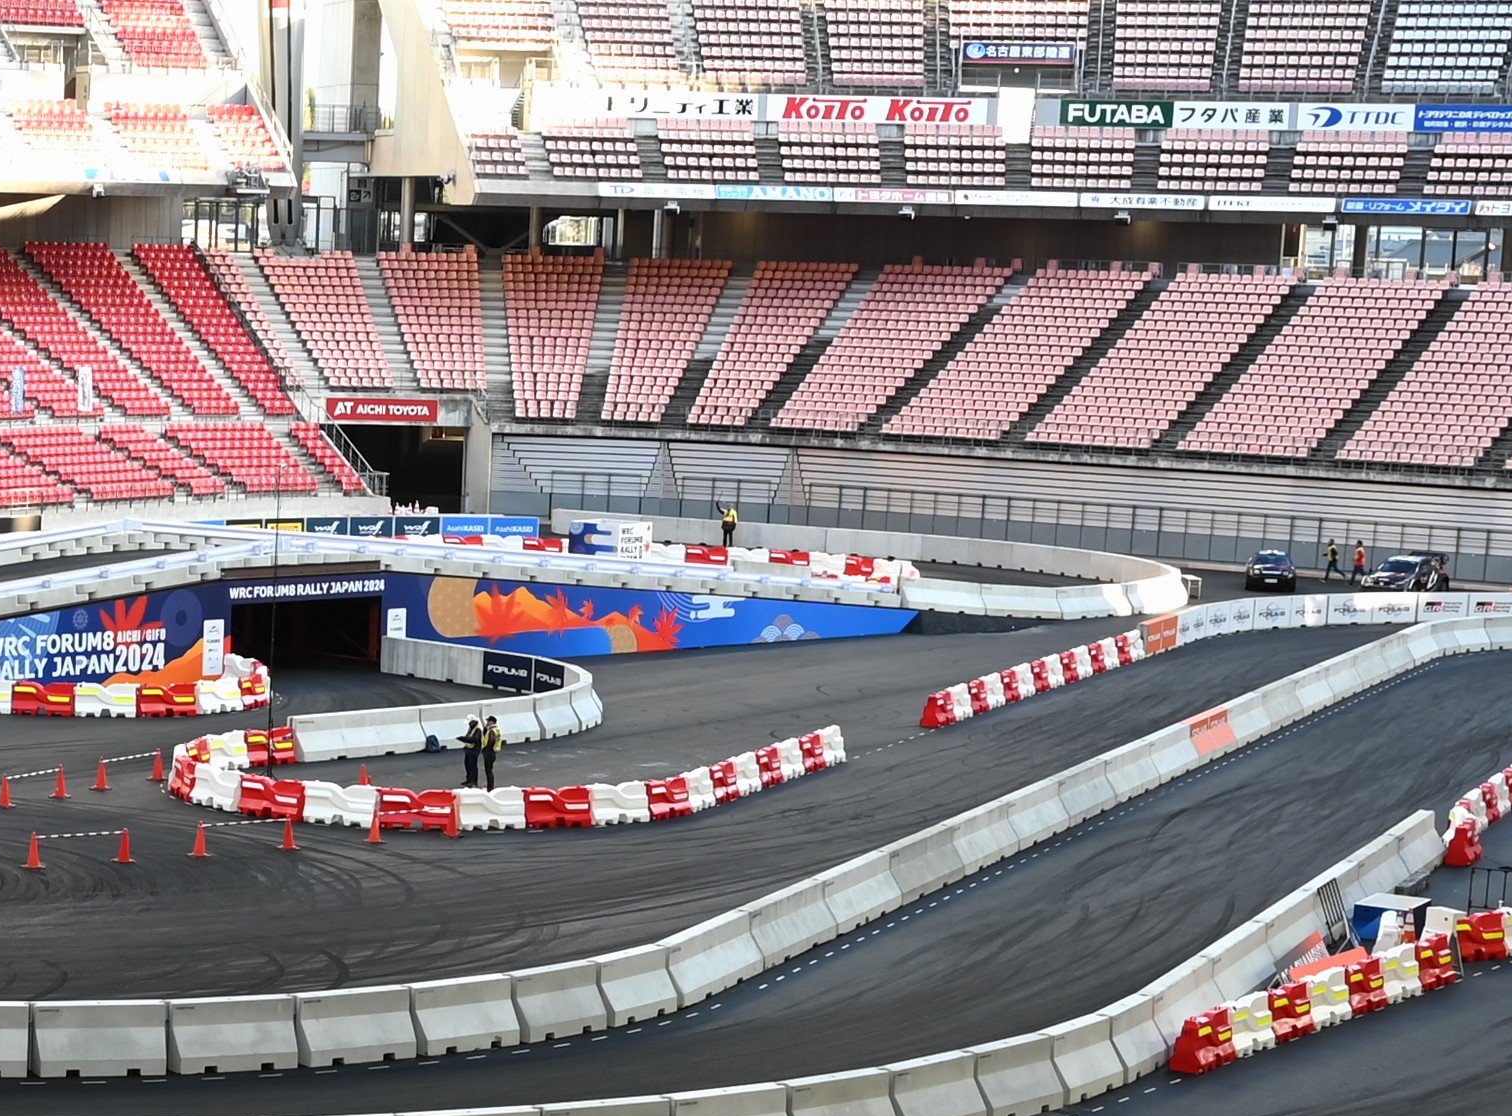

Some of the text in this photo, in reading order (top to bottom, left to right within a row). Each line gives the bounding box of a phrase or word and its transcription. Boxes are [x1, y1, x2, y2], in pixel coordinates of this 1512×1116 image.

[1067, 104, 1165, 124] FUTABA
[1179, 107, 1285, 124] フタバ産業
[1347, 111, 1406, 125] TTDC
[748, 186, 833, 200] AMANO
[356, 404, 386, 415] AICHI
[388, 405, 430, 416] TOYOTA
[229, 579, 385, 599] WRC FORUM8 RALLY JAPAN 2024
[37, 631, 115, 655] FORUM8
[52, 652, 115, 676] JAPAN
[115, 643, 165, 672] 2024
